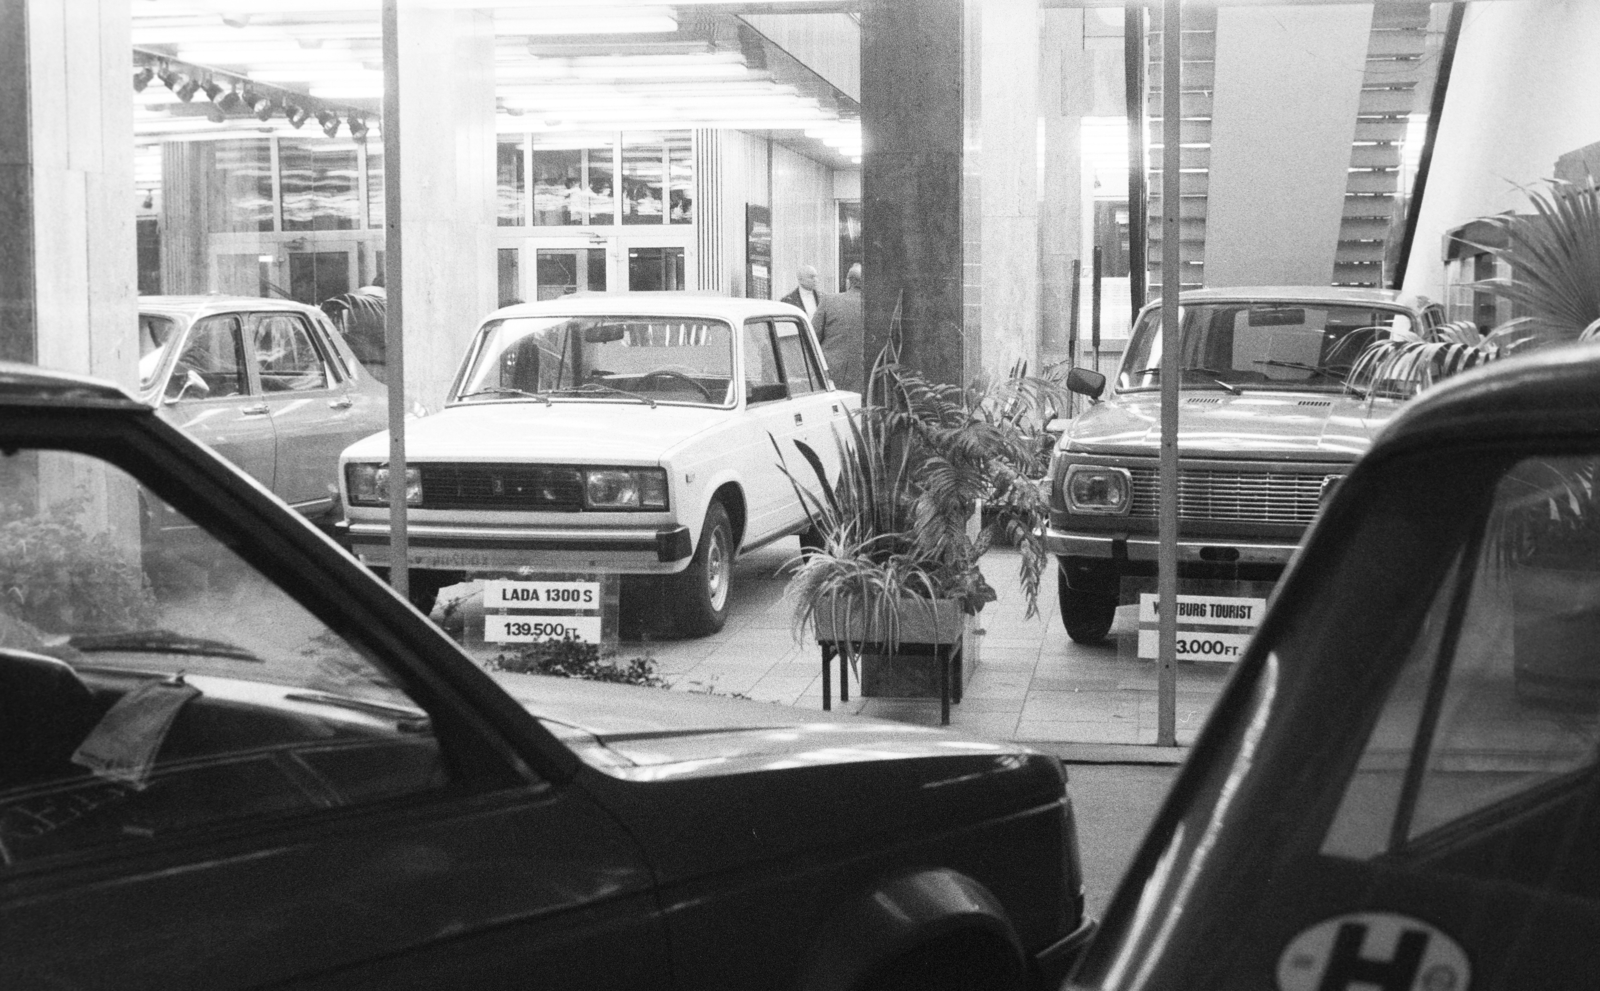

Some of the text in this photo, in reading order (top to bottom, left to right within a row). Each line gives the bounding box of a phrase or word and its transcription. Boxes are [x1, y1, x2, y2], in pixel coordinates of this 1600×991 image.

[502, 588, 595, 603] LADA 1300 S
[1209, 603, 1253, 620] TOURIST
[1316, 922, 1431, 991] H
